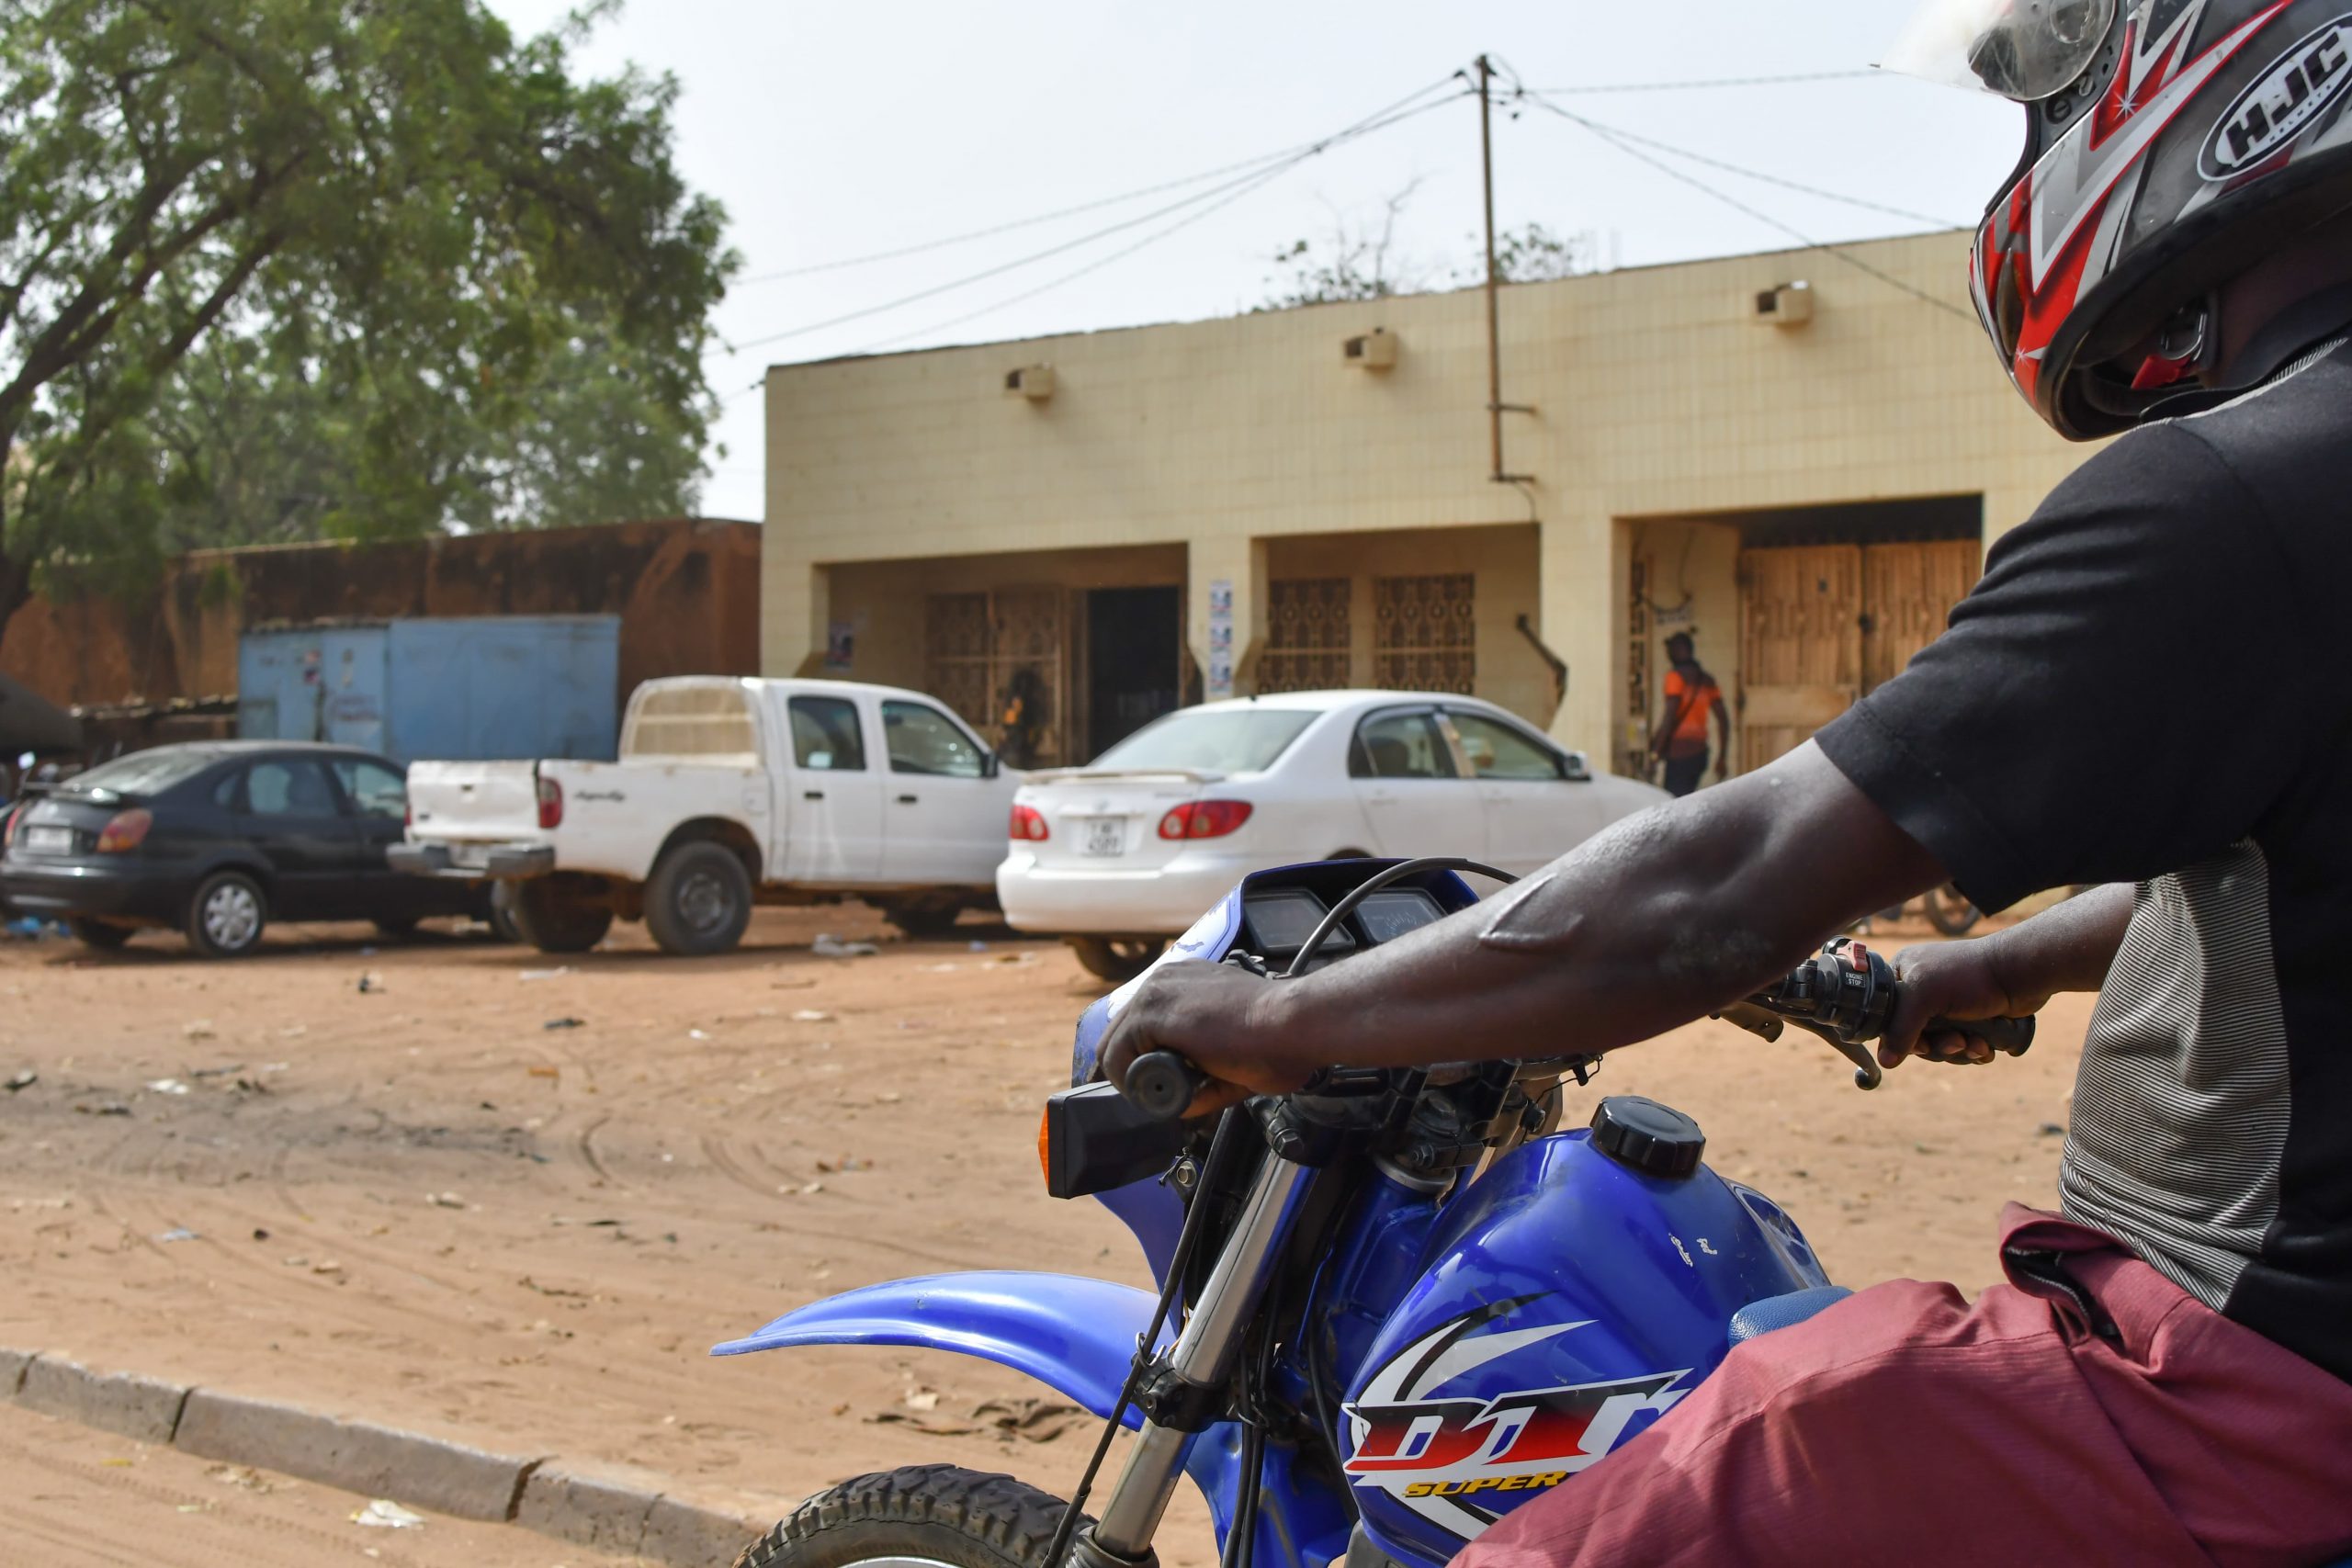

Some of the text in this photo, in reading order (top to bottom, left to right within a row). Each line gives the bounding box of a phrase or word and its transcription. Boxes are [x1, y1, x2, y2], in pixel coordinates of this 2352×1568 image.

[2225, 30, 2348, 162] HJC
[2269, 83, 2332, 143] HELMETS
[1845, 972, 1863, 981] ENGINE
[1402, 1470, 1567, 1498] SUPER
